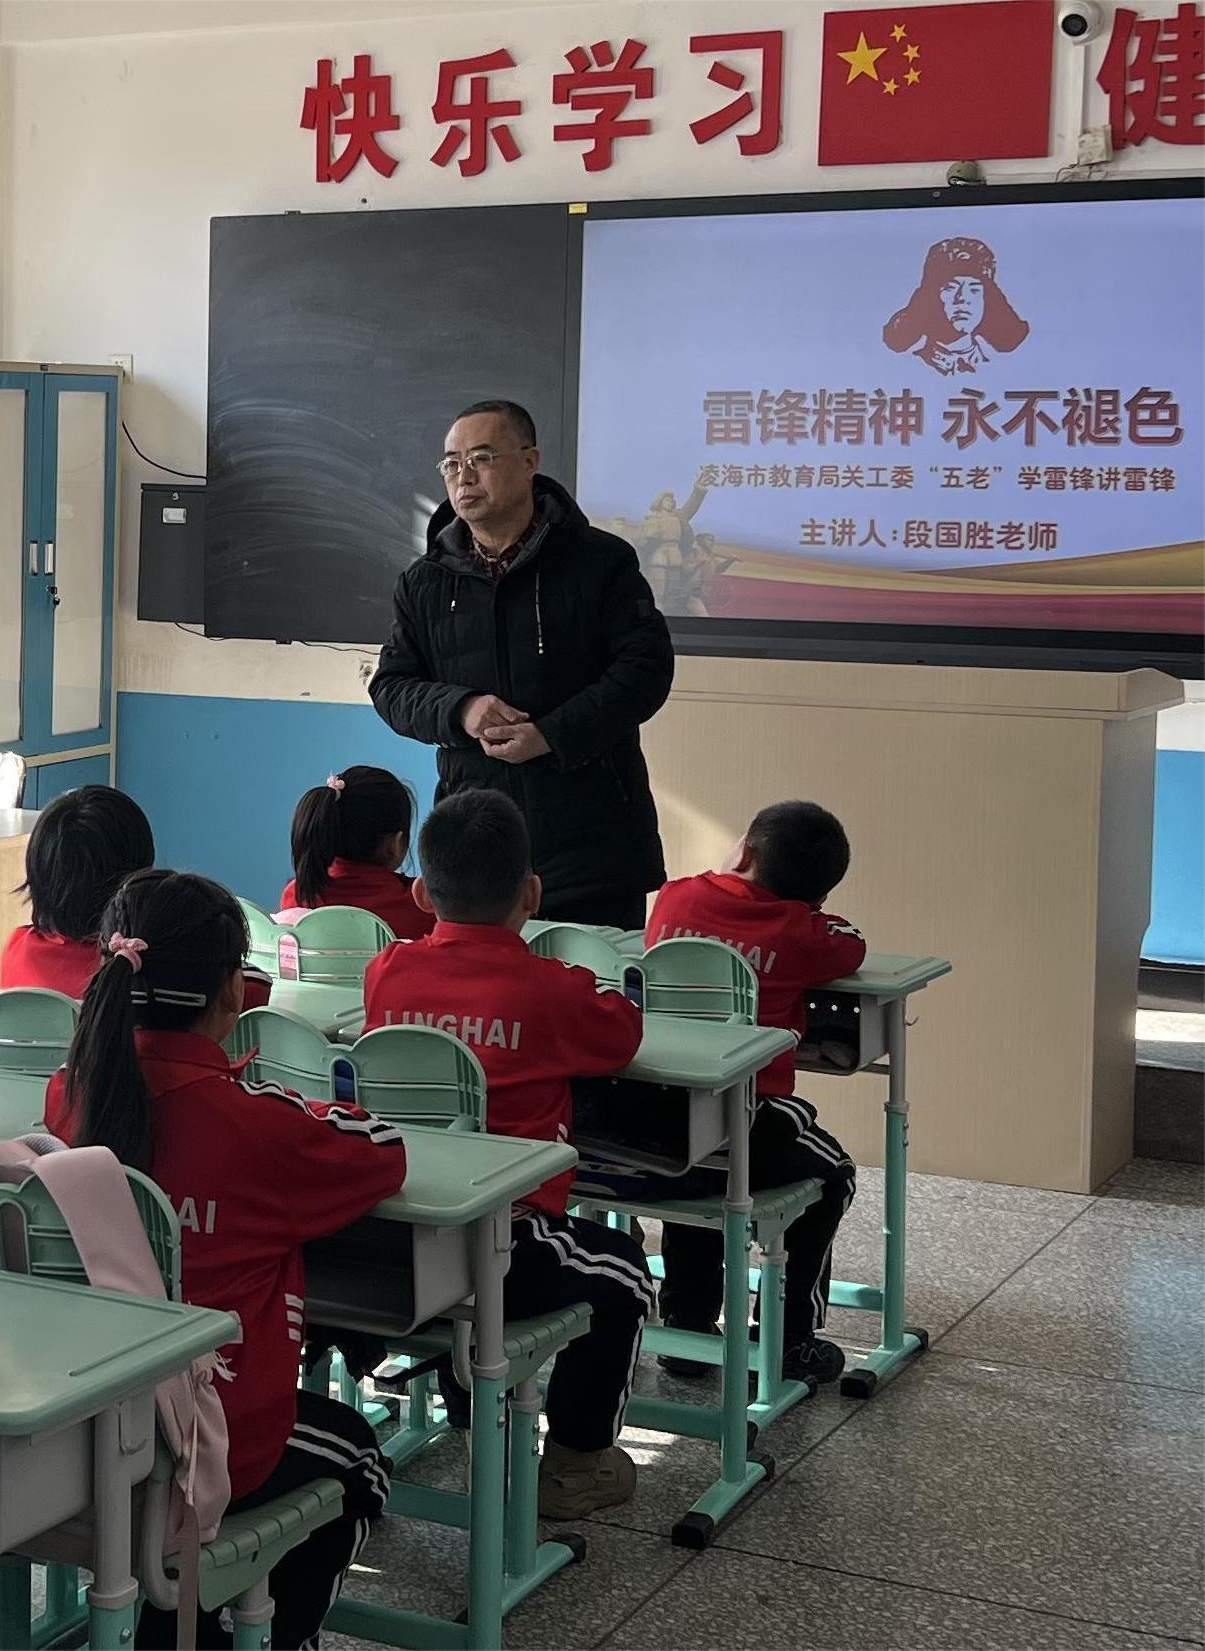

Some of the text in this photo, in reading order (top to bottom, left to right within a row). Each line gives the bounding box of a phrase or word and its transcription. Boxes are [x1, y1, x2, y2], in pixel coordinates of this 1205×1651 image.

[300, 30, 785, 184] 快乐学习
[1096, 3, 1205, 149] 健
[703, 386, 1185, 449] 雷锋精神 永不褪色
[799, 518, 1059, 552] 主讲人：段国胜老师
[166, 1194, 216, 1234] AI
